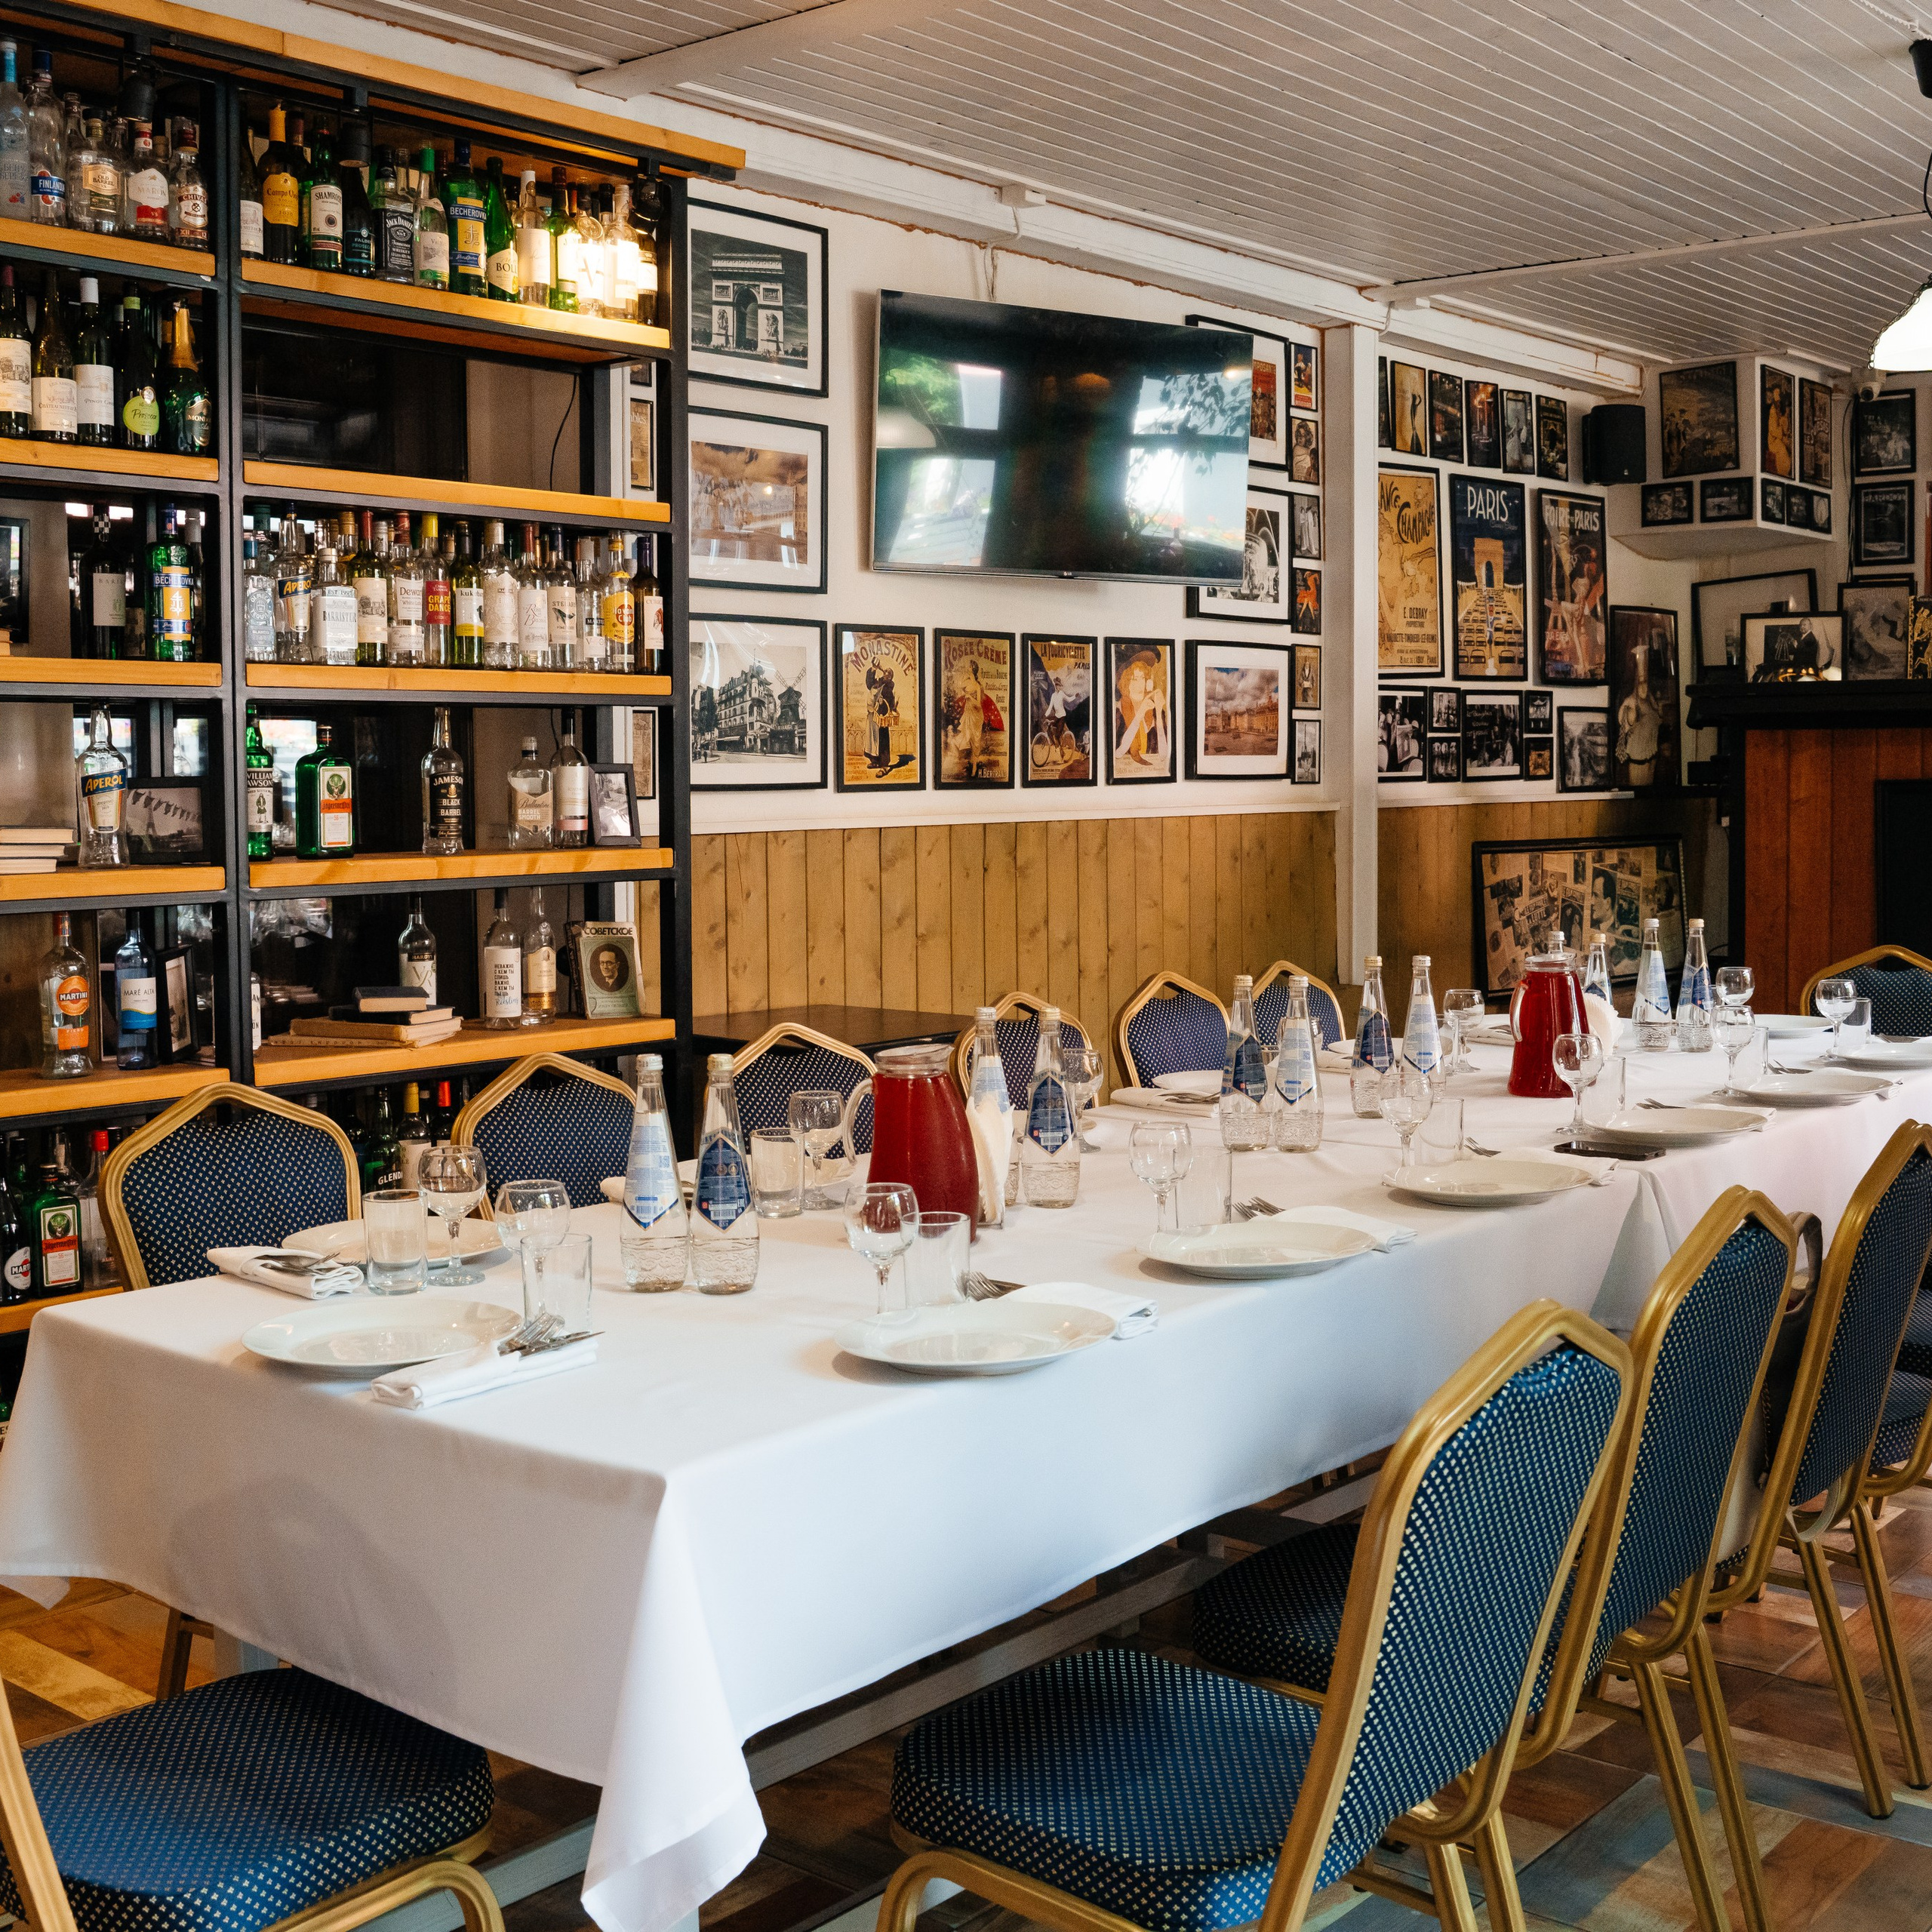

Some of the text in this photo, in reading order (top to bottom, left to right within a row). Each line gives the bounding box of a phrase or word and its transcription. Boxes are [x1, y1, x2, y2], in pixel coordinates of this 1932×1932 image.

[38, 179, 65, 191] FINLANDIA
[93, 177, 114, 186] BARREL
[266, 189, 288, 198] Campo
[1467, 484, 1509, 522] PARIS
[1397, 501, 1434, 545] CHAMPAGNE
[1545, 505, 1570, 528] FOIRE
[1574, 509, 1600, 531] PARIS
[428, 595, 451, 604] GRAPE
[428, 604, 451, 612] DANCE
[1409, 608, 1428, 619] DEBRAY
[323, 611, 357, 623] BARRISTER
[1041, 645, 1048, 657] LA
[850, 639, 915, 676] MONASTINE
[1073, 662, 1091, 670] PARIS
[85, 775, 124, 792] APEROL
[433, 775, 463, 786] JAMESON
[584, 927, 633, 936] СОВЕТСКОЕ
[60, 992, 88, 1001] MARTINI
[124, 988, 140, 996] MARÉ
